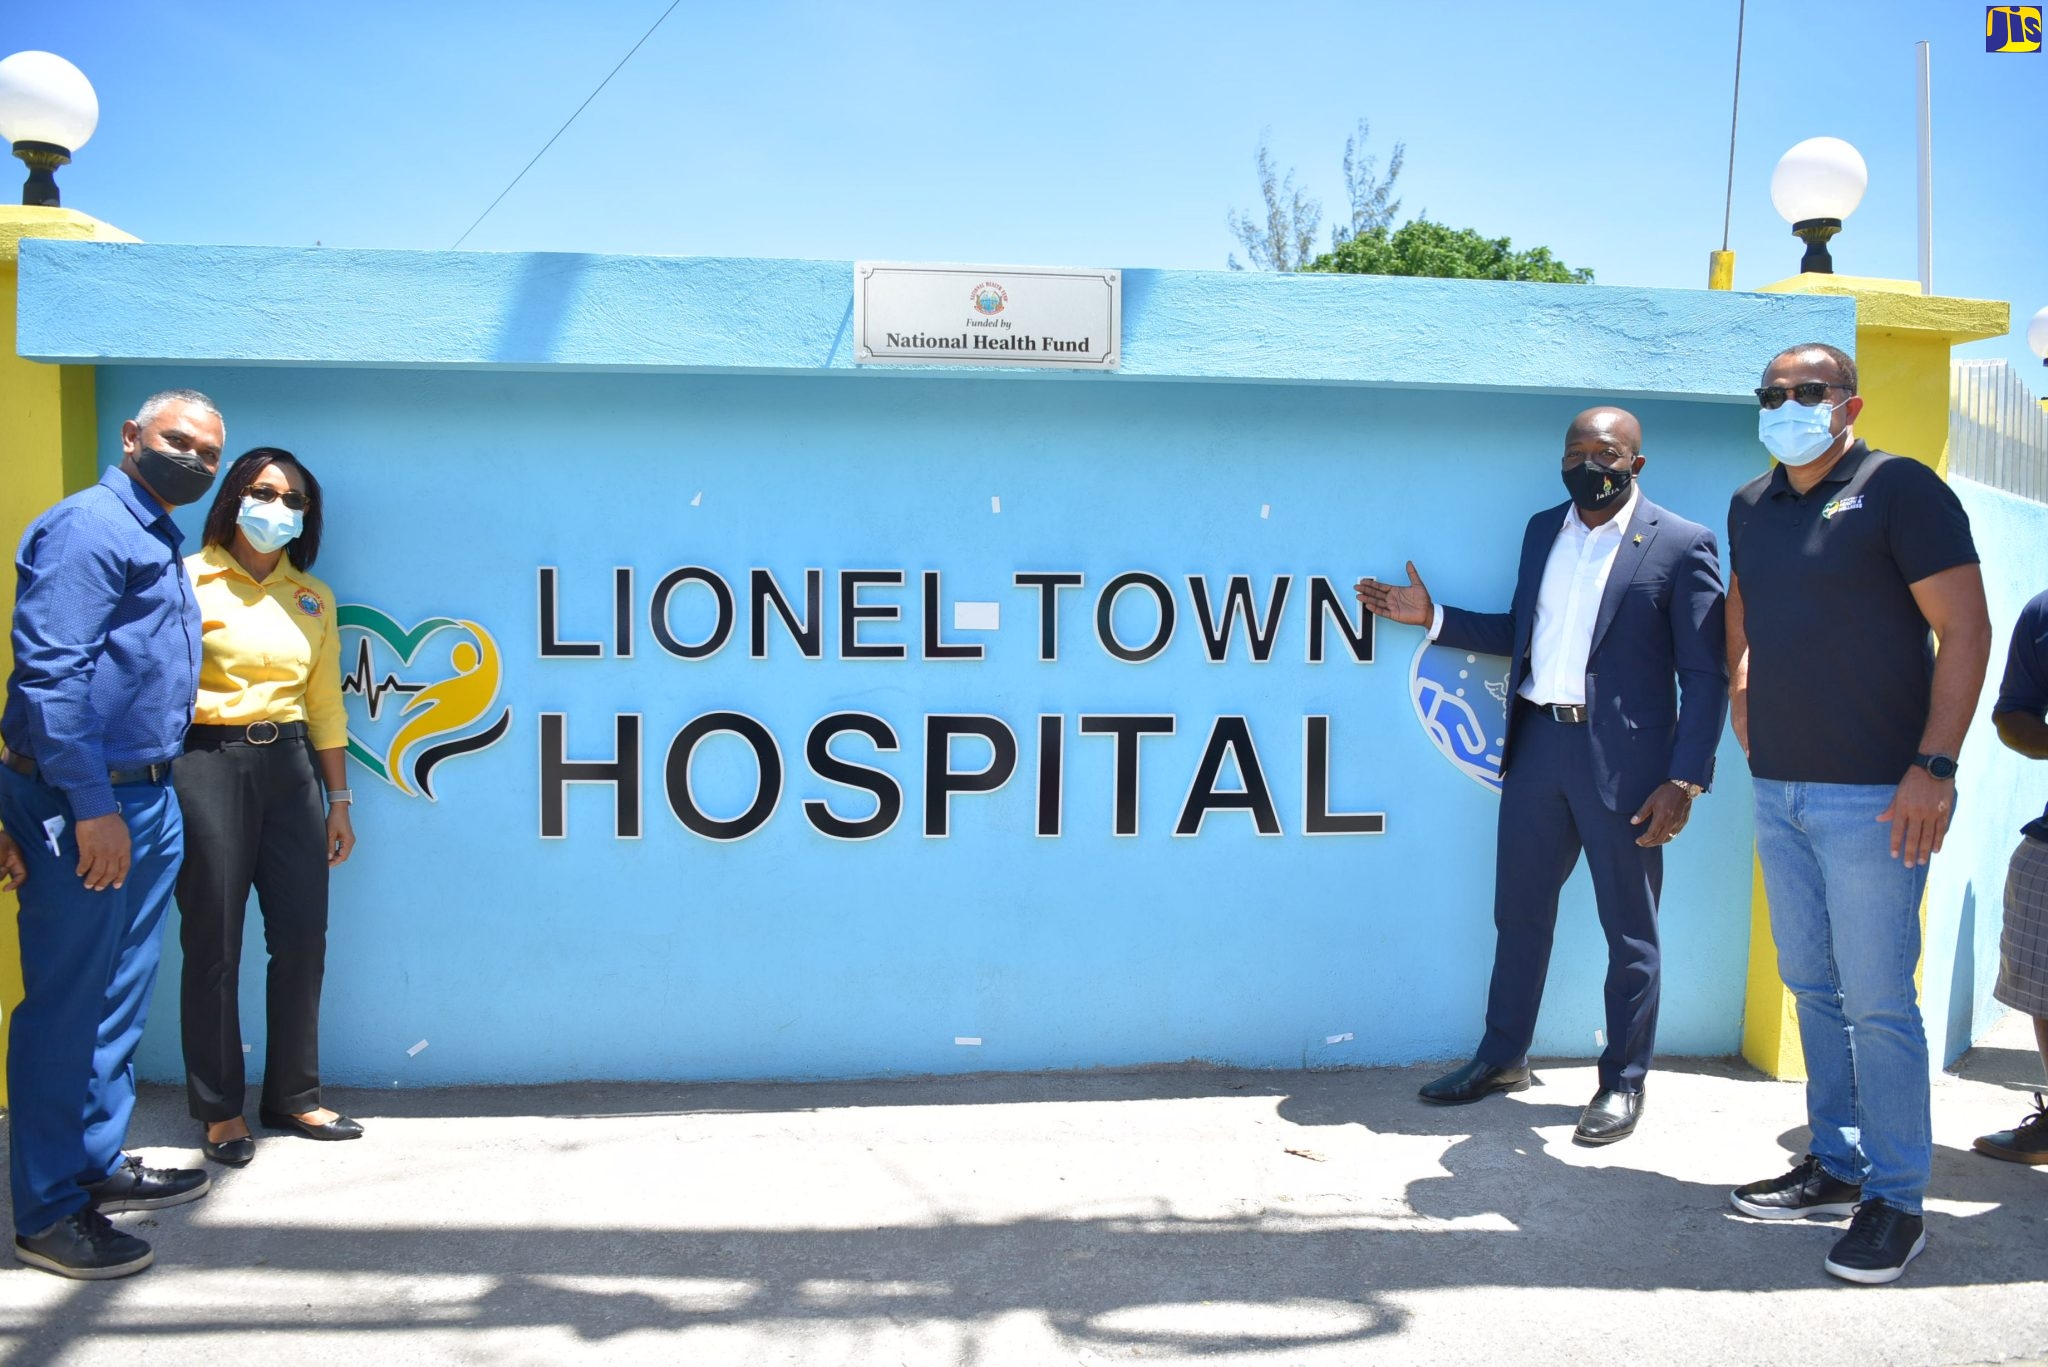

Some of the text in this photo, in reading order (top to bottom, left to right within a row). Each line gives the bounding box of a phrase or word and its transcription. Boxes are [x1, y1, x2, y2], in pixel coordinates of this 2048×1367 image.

[886, 332, 1090, 353] National Health Fund
[966, 318, 1012, 331] Funded by
[539, 566, 1377, 664] LIONEL TOWN
[539, 710, 1386, 843] HOSPITAL
